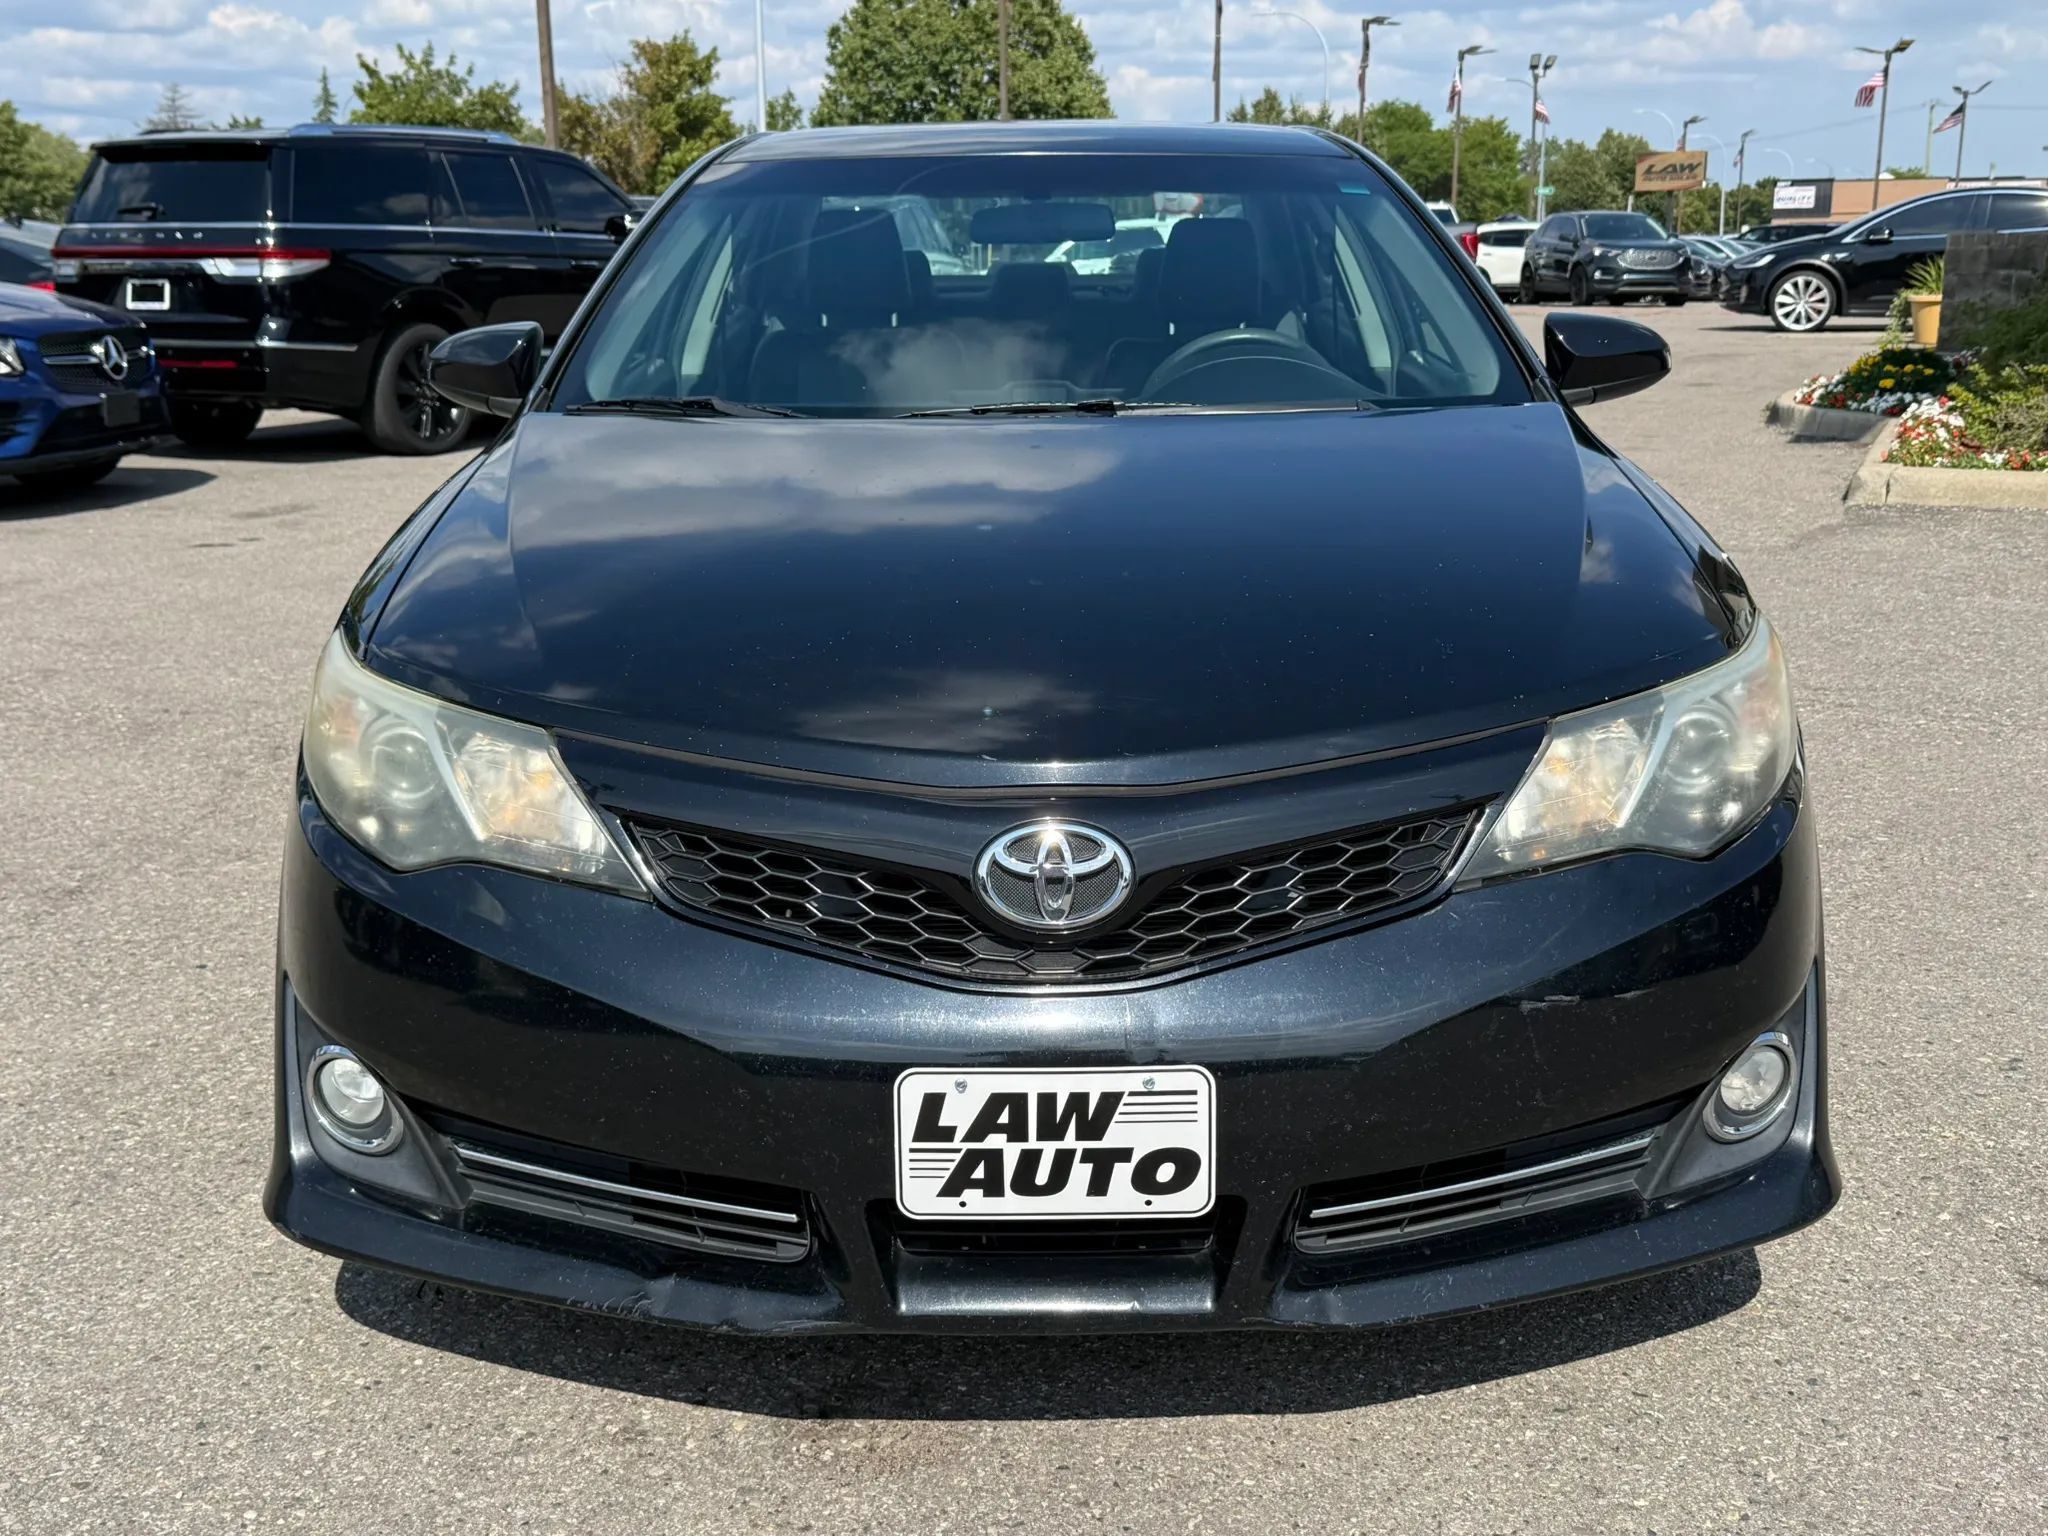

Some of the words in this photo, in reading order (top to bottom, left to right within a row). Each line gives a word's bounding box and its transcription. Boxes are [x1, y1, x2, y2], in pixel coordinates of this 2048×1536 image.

[1642, 162, 1702, 175] LAW
[911, 1091, 1126, 1143] LAW
[936, 1147, 1202, 1198] AUTO
